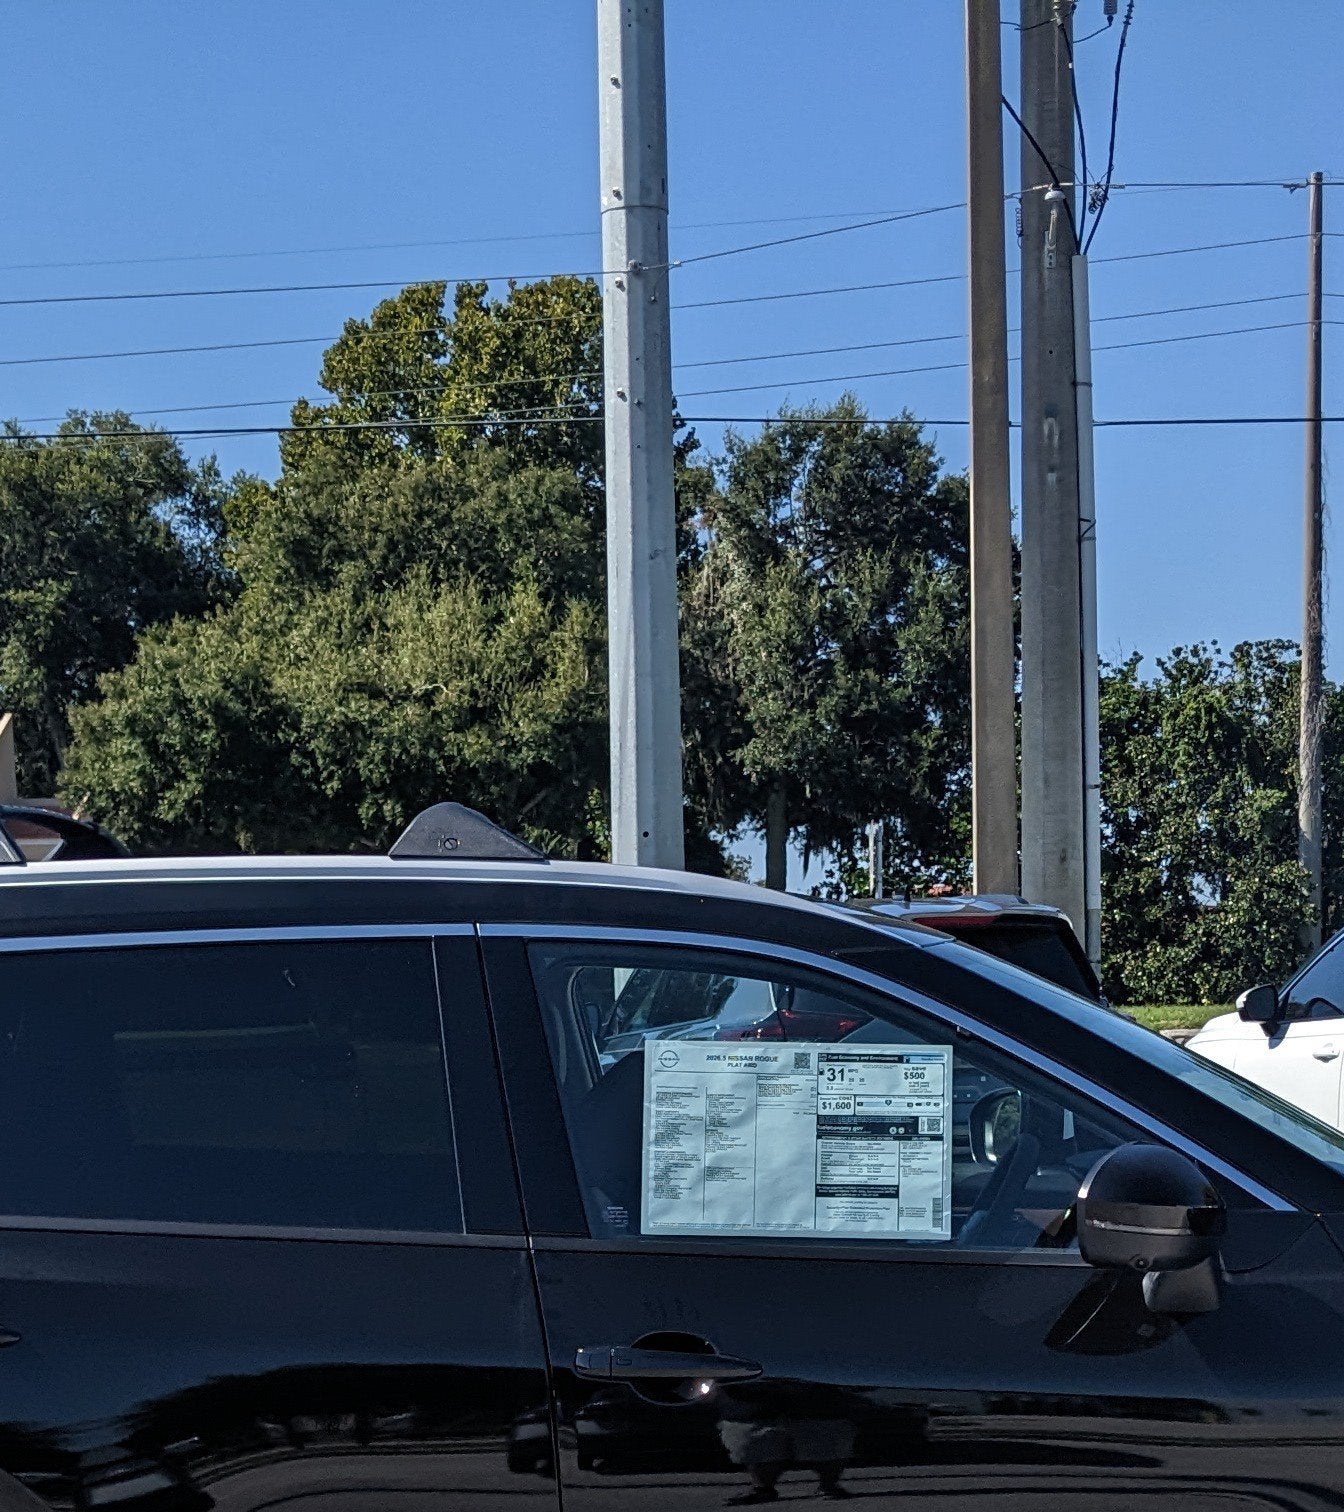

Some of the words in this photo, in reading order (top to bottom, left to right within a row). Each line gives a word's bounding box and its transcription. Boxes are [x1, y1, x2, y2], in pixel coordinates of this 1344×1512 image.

[754, 1055, 779, 1063] ROGUE
[826, 1067, 845, 1082] 31
[903, 1071, 926, 1081] $500
[821, 1101, 852, 1111] $1,600
